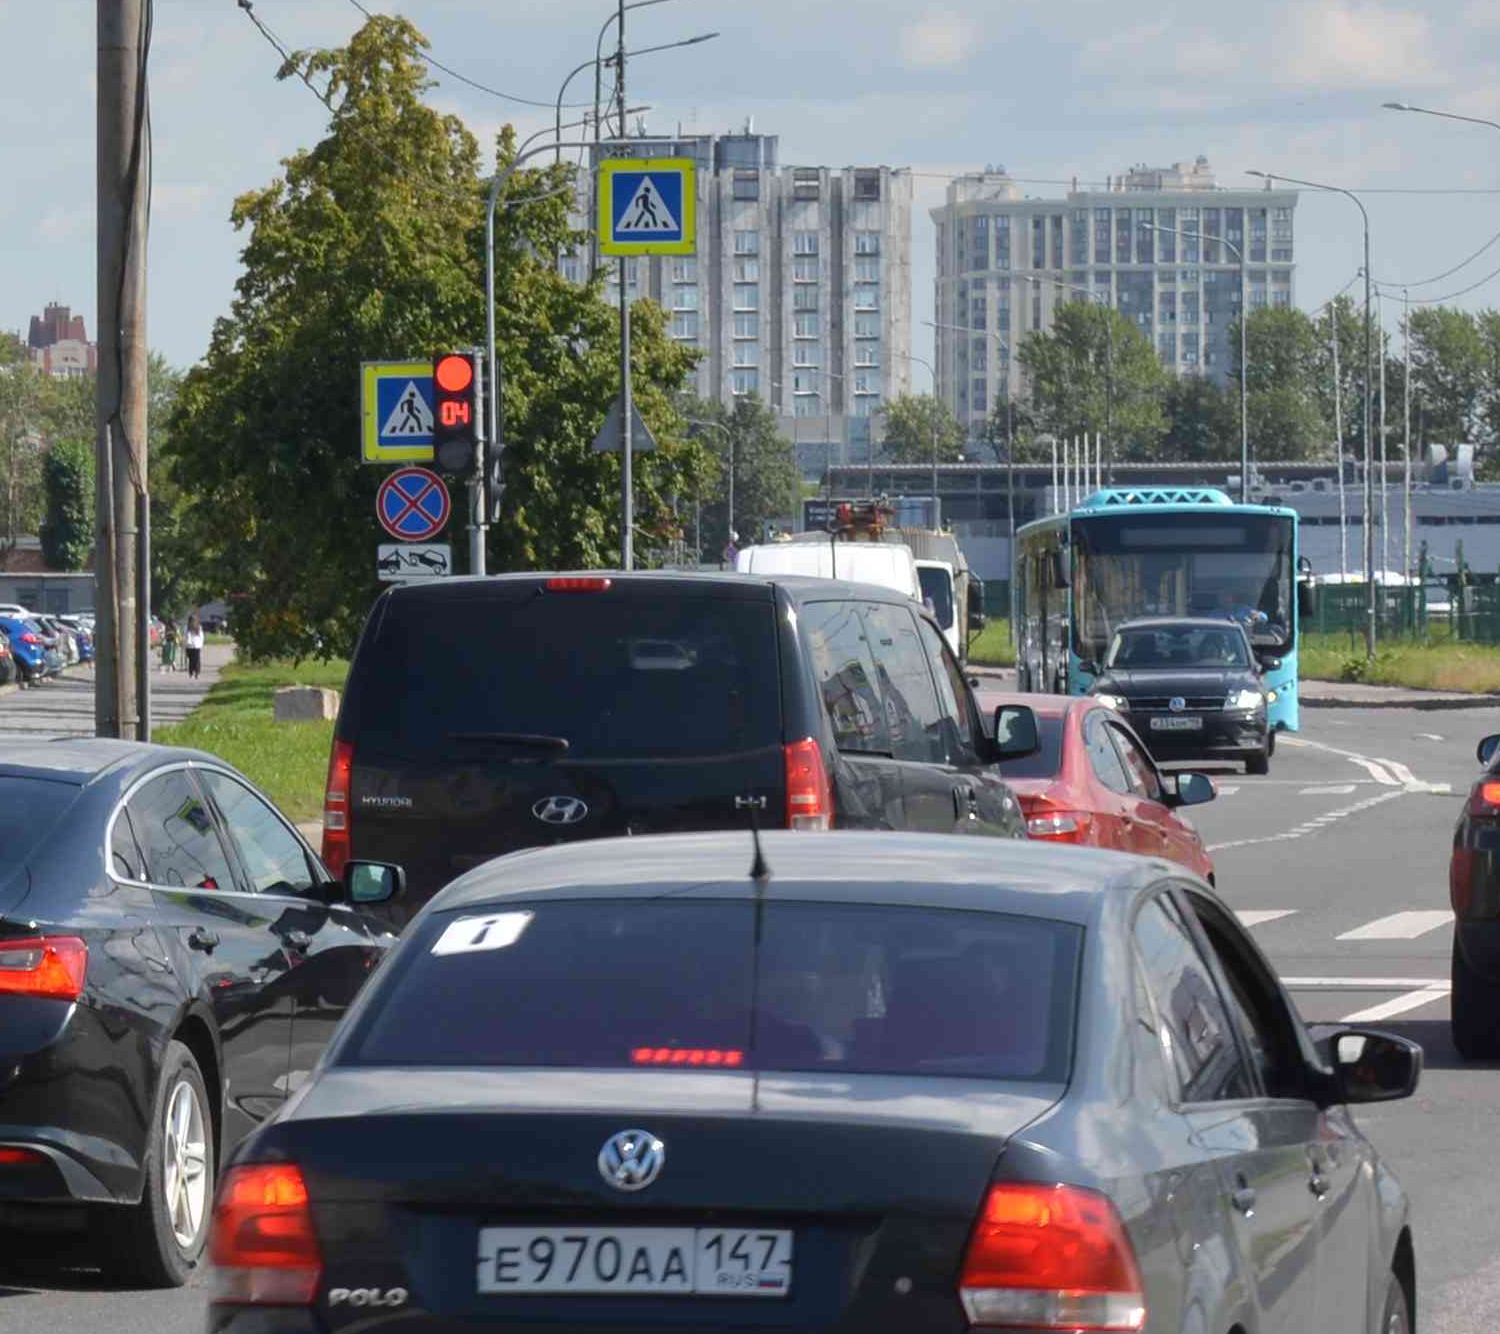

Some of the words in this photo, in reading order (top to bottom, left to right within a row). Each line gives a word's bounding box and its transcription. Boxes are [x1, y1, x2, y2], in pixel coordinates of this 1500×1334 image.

[441, 400, 469, 426] 04
[362, 796, 413, 808] HYUNDAI
[718, 1273, 754, 1289] RUS
[328, 1288, 409, 1308] POLO
